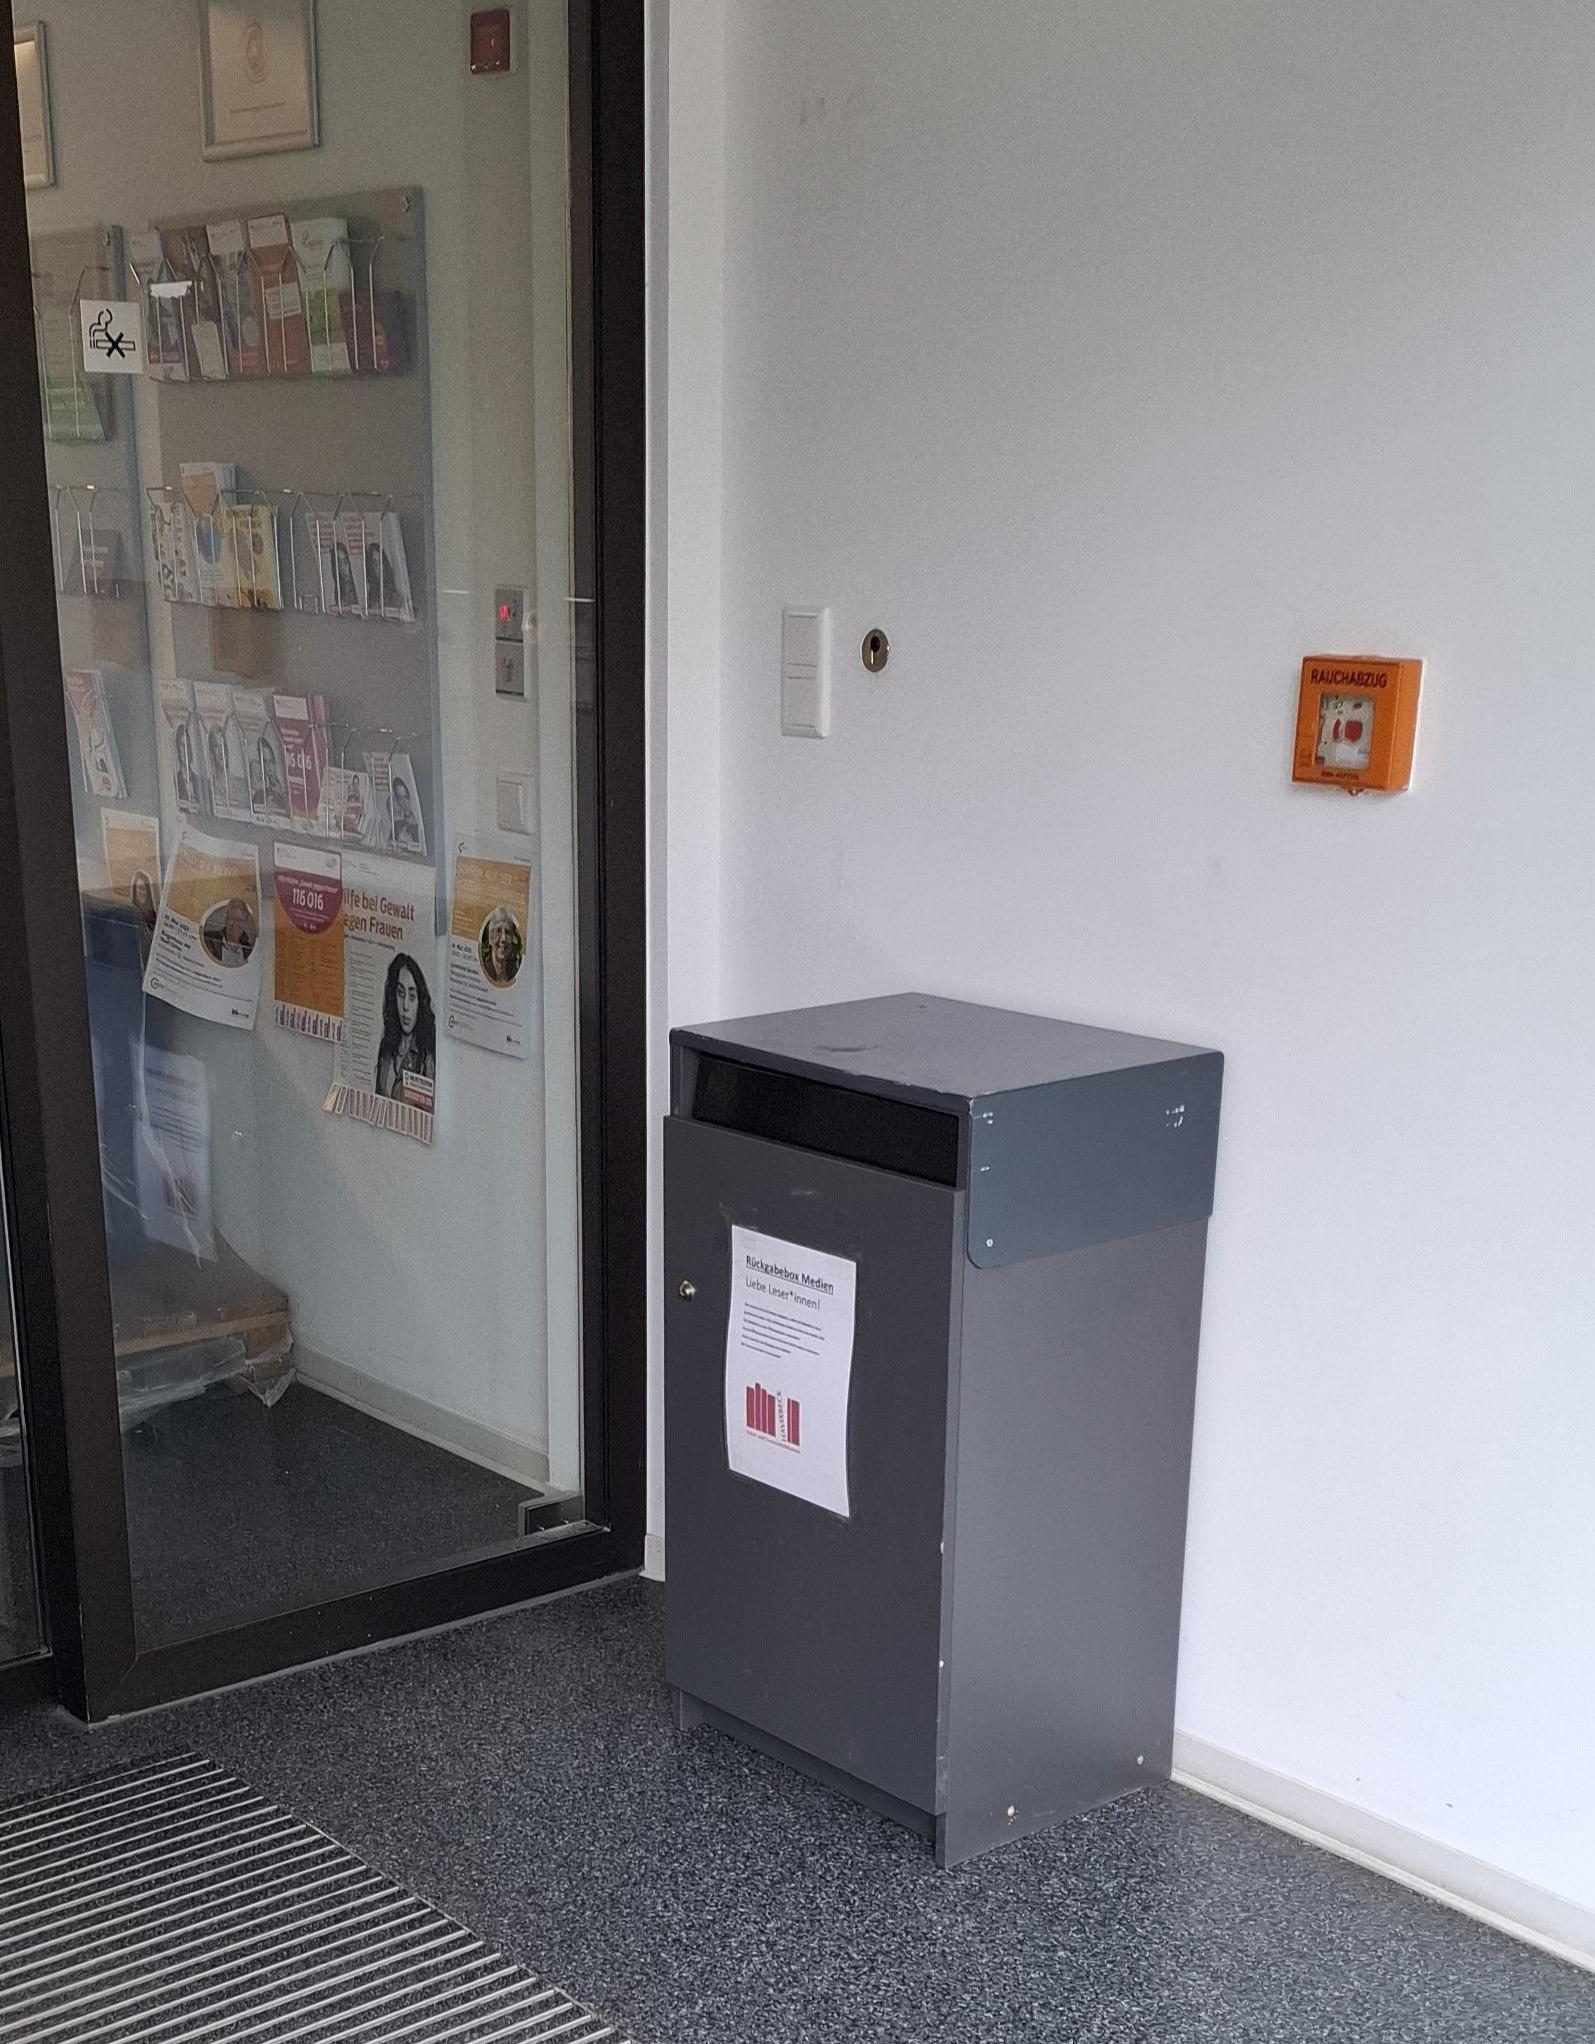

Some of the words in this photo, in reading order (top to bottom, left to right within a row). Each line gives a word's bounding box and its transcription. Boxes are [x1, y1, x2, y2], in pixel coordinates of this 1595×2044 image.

[1310, 669, 1388, 688] RAUCHABZUG
[293, 888, 306, 907] 116
[307, 891, 324, 911] 016
[343, 887, 361, 910] ilfe
[362, 891, 379, 912] bei
[380, 897, 415, 922] Gewalt
[343, 913, 367, 932] egen
[369, 916, 403, 941] Frauen
[745, 1276, 767, 1293] Liebe
[746, 1255, 800, 1283] Rückgabebox
[801, 1273, 834, 1293] Medien
